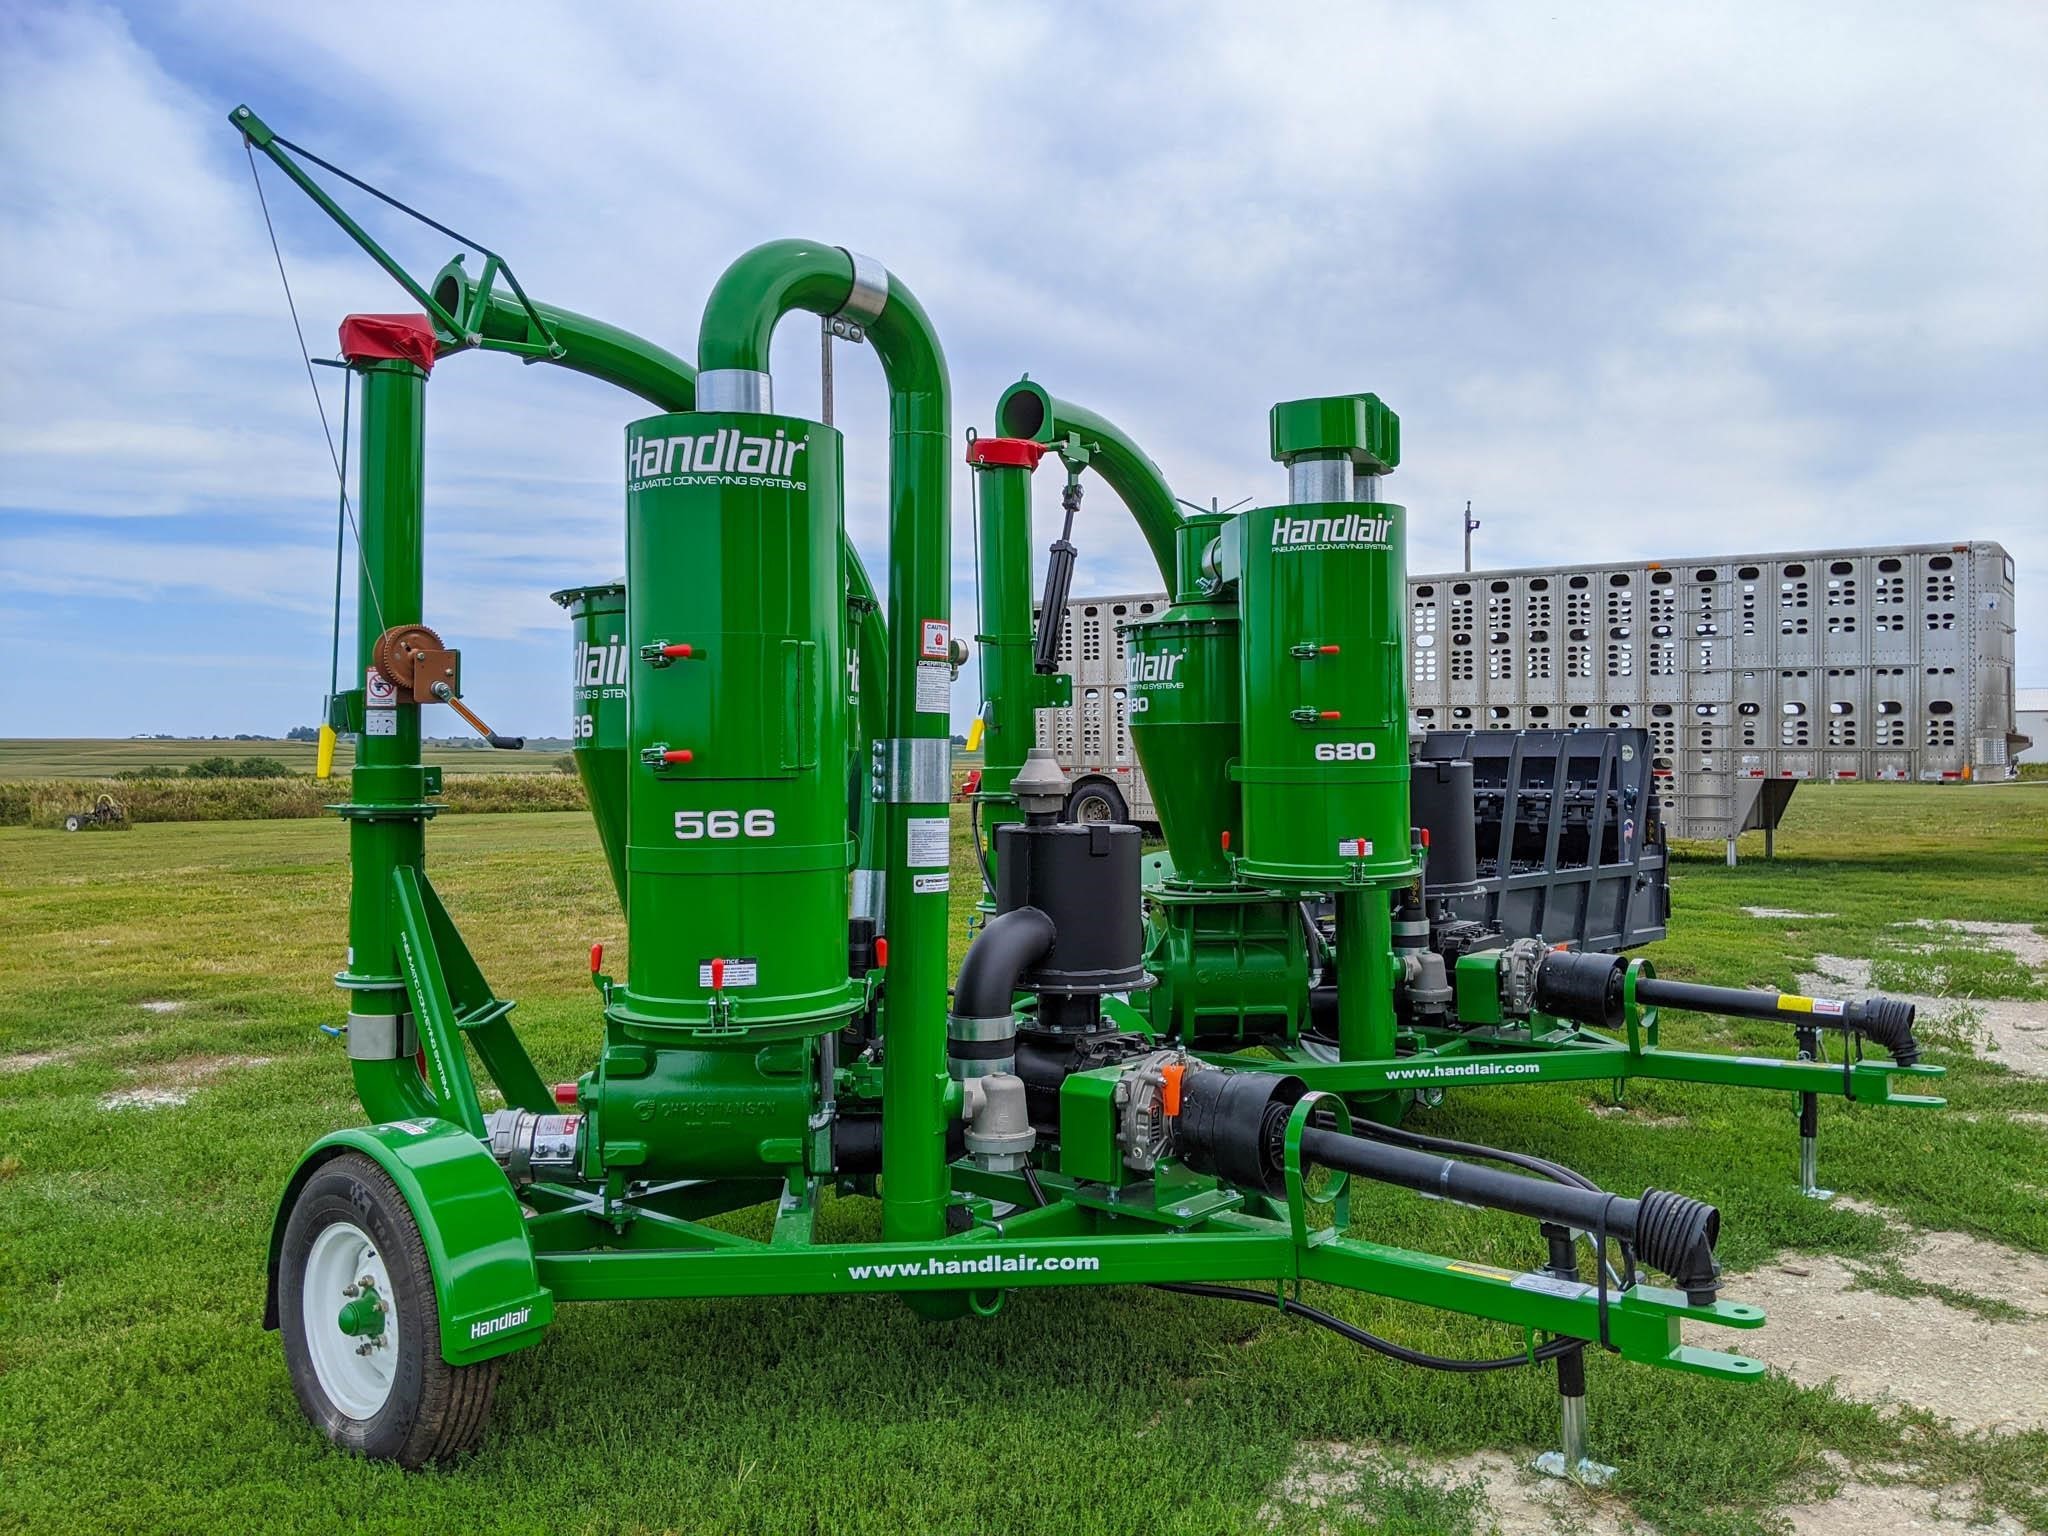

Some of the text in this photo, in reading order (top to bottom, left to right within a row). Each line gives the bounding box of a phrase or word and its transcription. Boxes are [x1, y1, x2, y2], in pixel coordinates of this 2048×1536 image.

[628, 428, 806, 481] Handlair
[673, 475, 748, 486] CONVEYING
[749, 478, 807, 491] SYSTEMS
[1272, 513, 1393, 545] Handlair
[1271, 543, 1393, 553] PNEUMATIC CONVEYING SYSTEMS
[1149, 682, 1185, 690] SYSTEMS
[1315, 742, 1376, 761] 680
[674, 808, 775, 840] 566
[401, 931, 451, 1101] PNEUMATIC CONVEYING SYSTEMS
[1385, 1062, 1540, 1081] www.handlair.com
[848, 1254, 1100, 1280] www.handlair.com
[471, 1307, 532, 1340] Handlair
